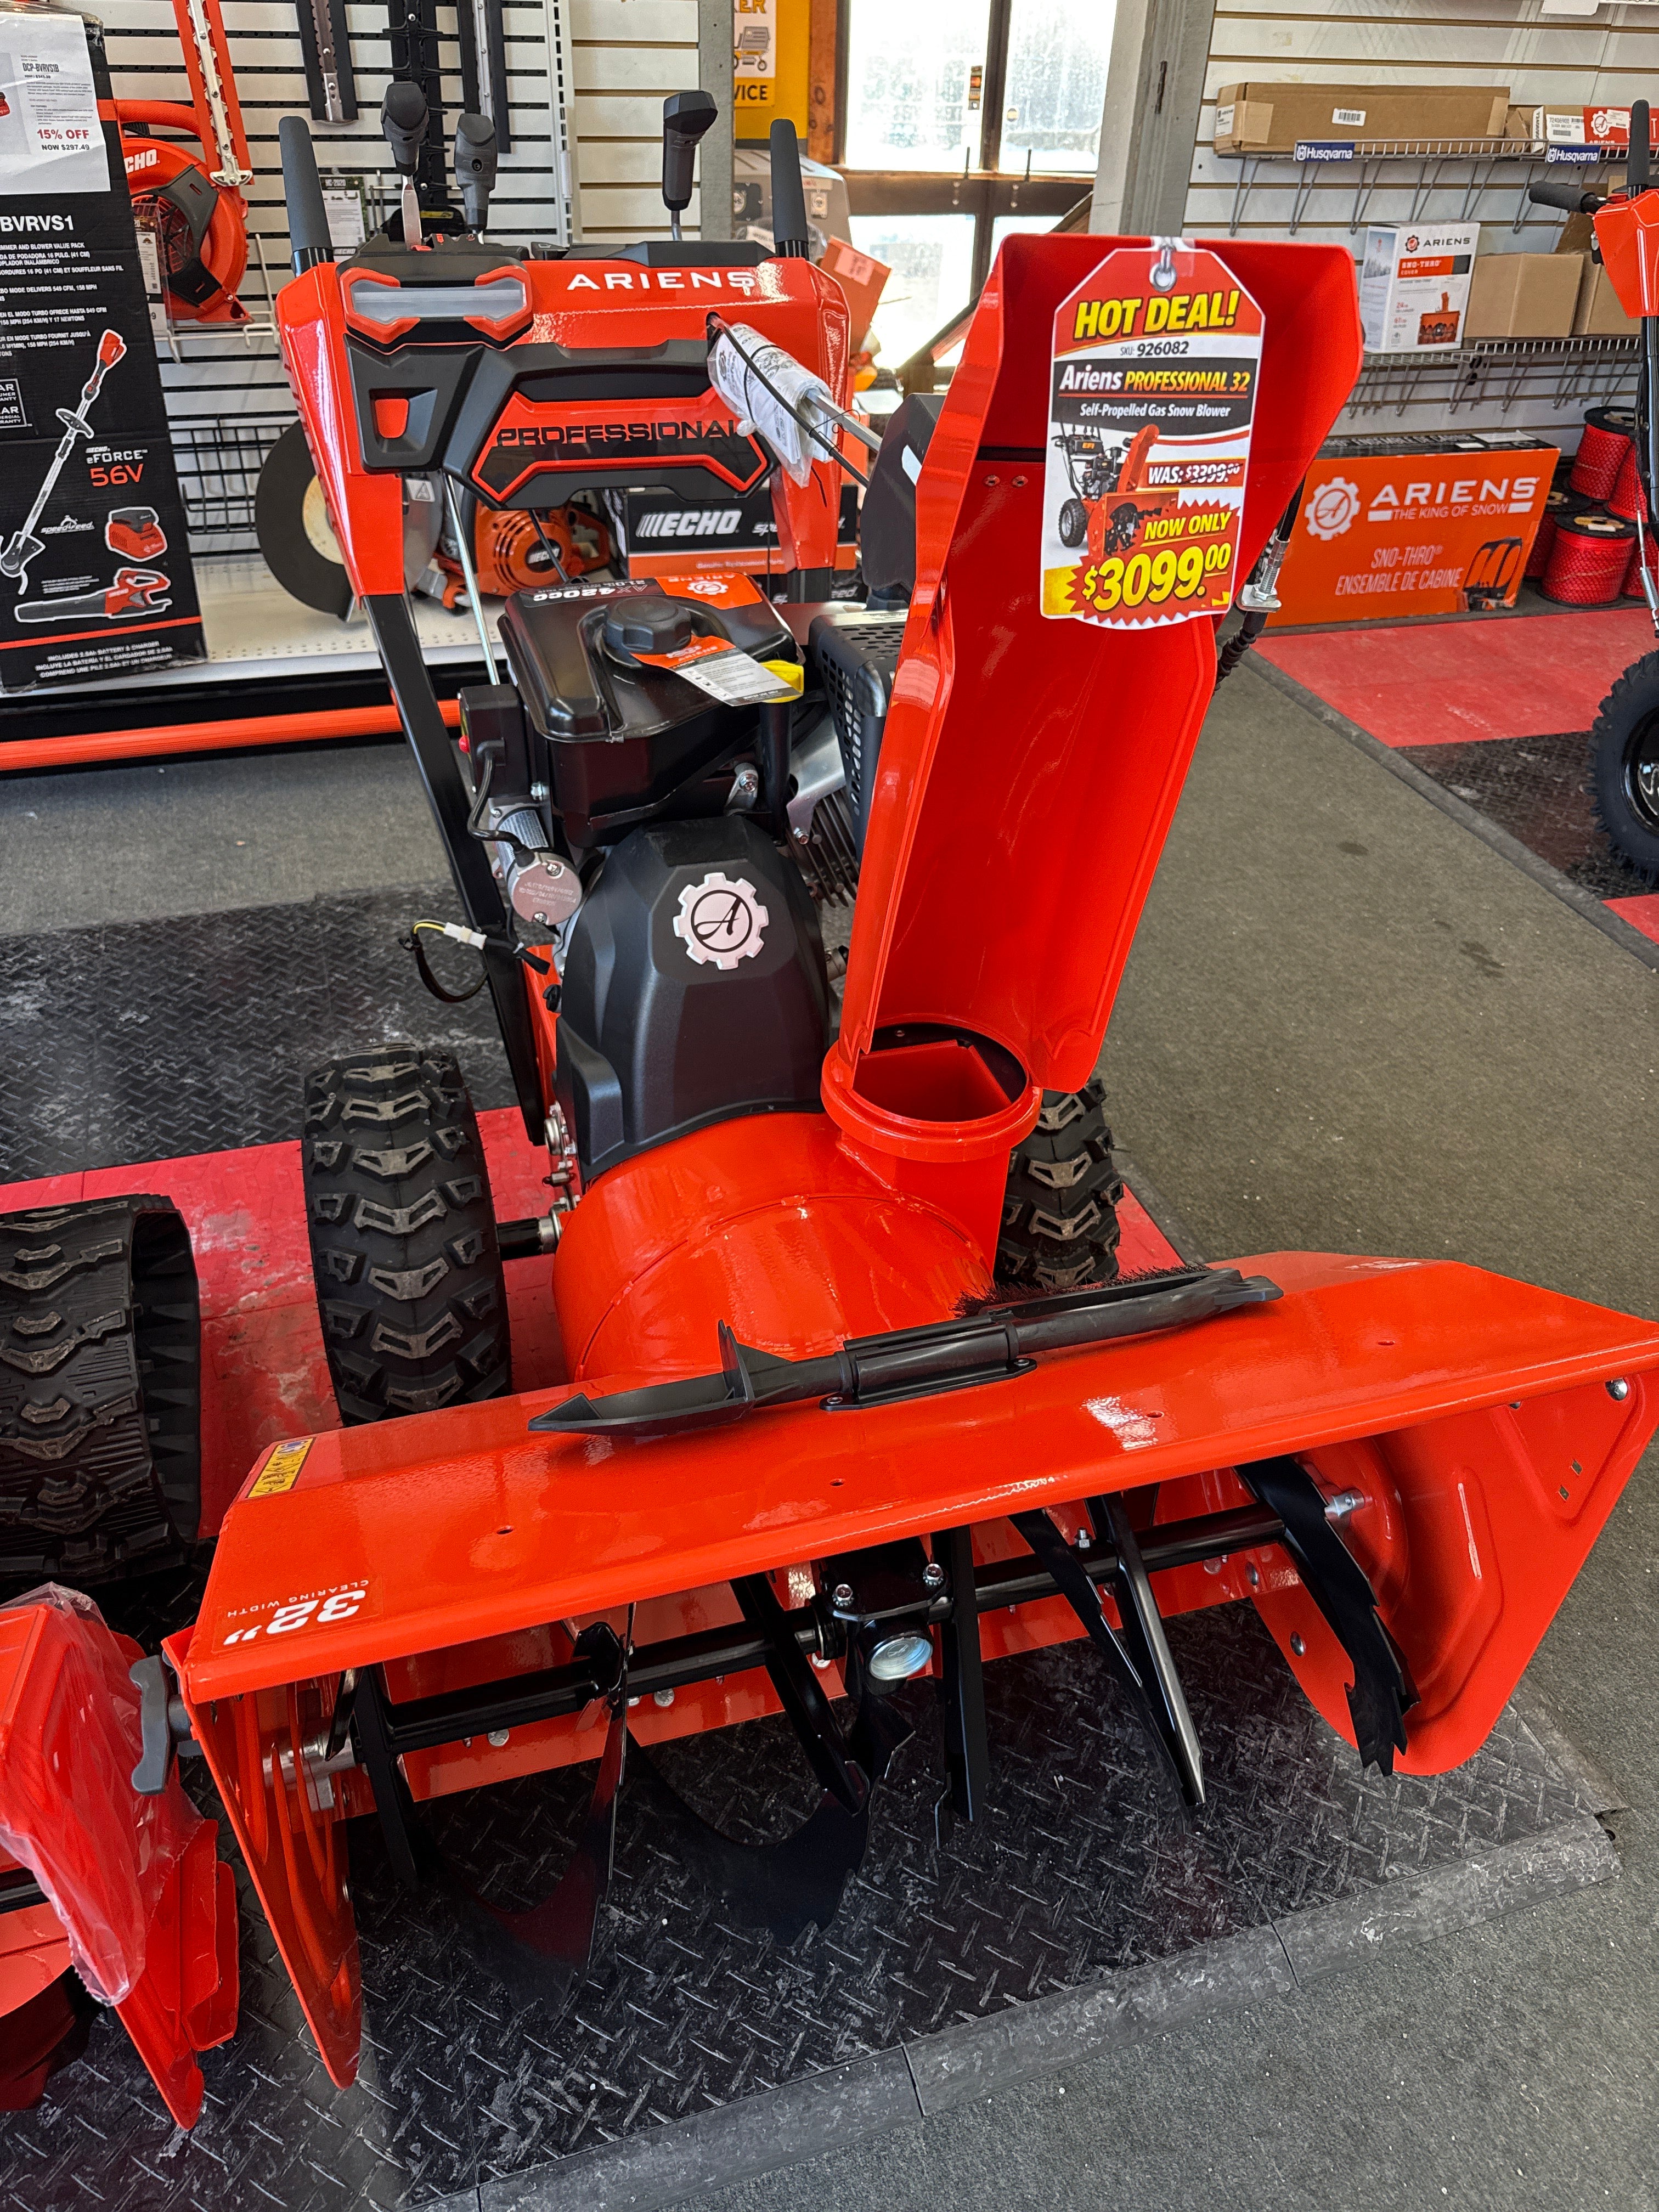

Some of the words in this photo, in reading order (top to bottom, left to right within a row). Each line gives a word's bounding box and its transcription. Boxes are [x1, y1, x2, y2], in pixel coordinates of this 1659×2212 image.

[22, 63, 59, 72] DCP-BVRVS1B
[37, 129, 63, 139] 15%
[66, 129, 89, 139] OFF
[124, 149, 157, 173] CHO
[1306, 147, 1353, 161] Husqvarna
[1556, 149, 1598, 163] Husqvarna
[0, 215, 74, 232] BVRVS1
[1424, 237, 1471, 247] ARIENS
[567, 272, 755, 290] ARIENS
[1074, 298, 1142, 340] HOT
[1143, 290, 1240, 334] DEAL!
[1120, 346, 1135, 356] SKU:
[1137, 341, 1189, 357] 926082
[1059, 364, 1123, 390] Ariens
[1123, 370, 1228, 392] PROFESSIONAL
[1229, 371, 1251, 392] 32
[1080, 403, 1147, 419] Self-Propelled
[1148, 404, 1166, 417] Gas
[1167, 405, 1195, 417] Snow
[1196, 404, 1231, 417] Blower
[89, 464, 144, 487] 56V
[1148, 466, 1184, 484] WAS:
[1370, 477, 1538, 507] ARIENS
[1392, 509, 1417, 521] THE
[1419, 506, 1449, 520] KING
[1451, 505, 1469, 517] OF
[1471, 503, 1509, 516] SNOW
[658, 510, 742, 537] ECHO
[1144, 517, 1186, 541] NOW
[1188, 511, 1233, 533] ONLY
[1081, 543, 1232, 612] $3099.00
[1335, 572, 1401, 595] ENSEMBLE
[1401, 571, 1420, 591] DE
[1419, 567, 1464, 590] CABINE
[289, 1579, 369, 1603] CLEARING
[227, 1600, 280, 1618] WIDTH
